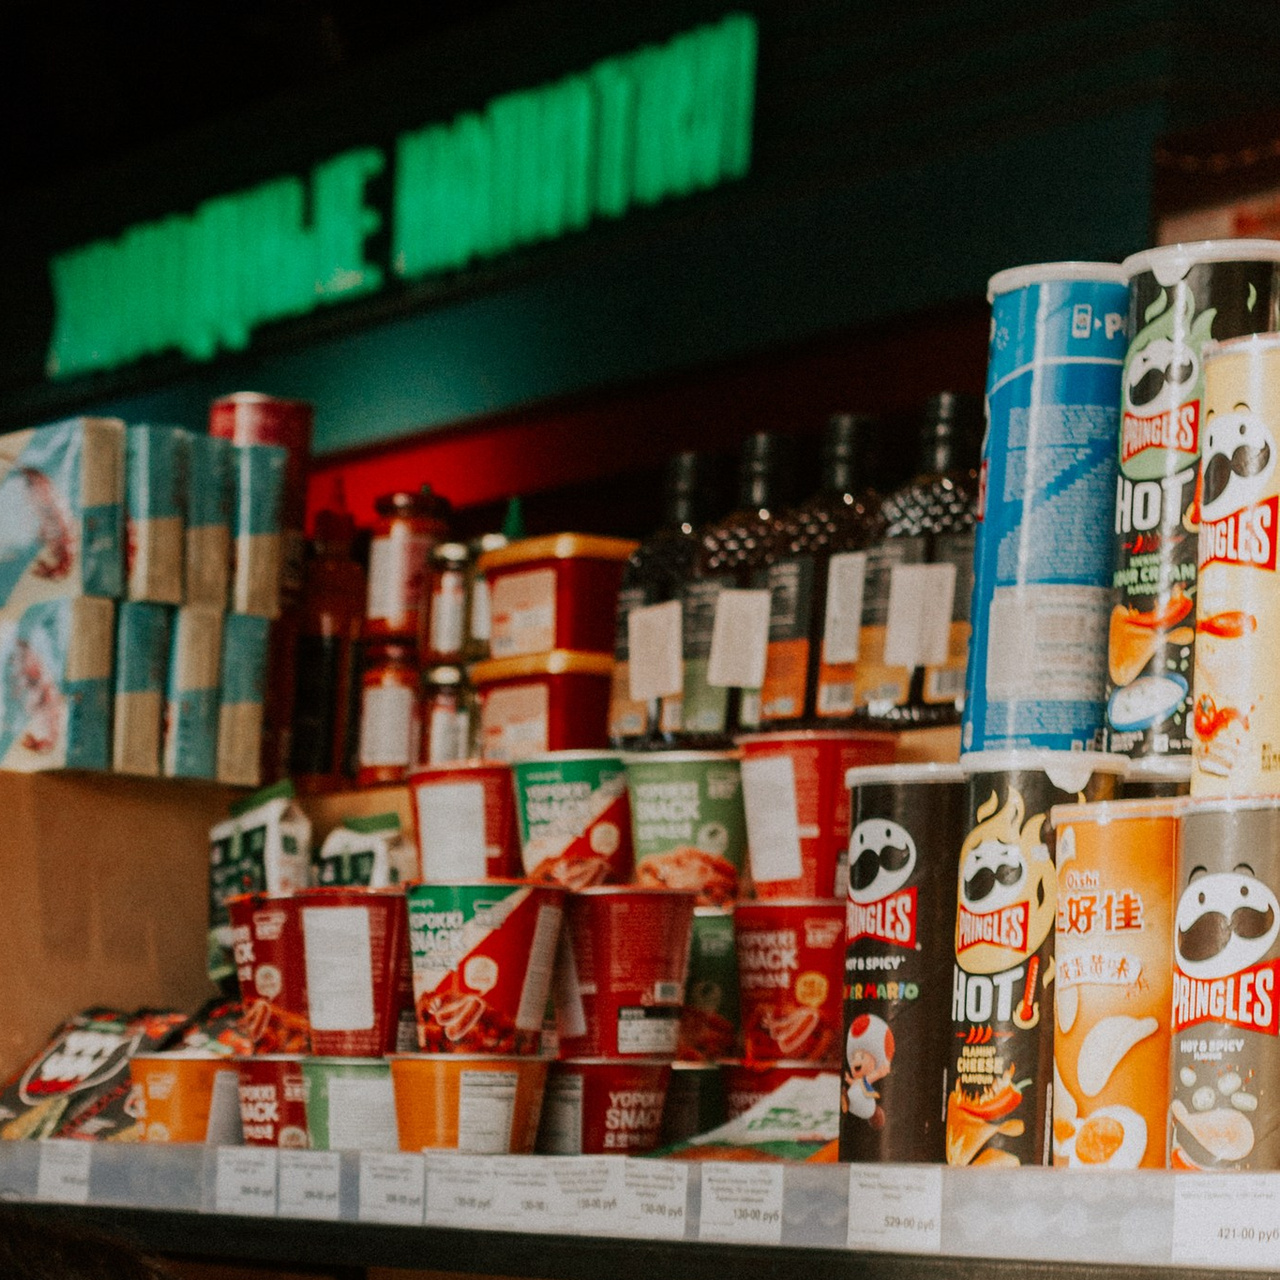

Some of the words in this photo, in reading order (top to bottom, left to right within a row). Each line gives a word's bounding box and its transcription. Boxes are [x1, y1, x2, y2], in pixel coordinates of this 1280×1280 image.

[1115, 468, 1195, 534] HOT
[958, 906, 1025, 949] PRINGLES
[865, 981, 919, 1000] MARIO
[1171, 968, 1274, 1028] PRINGLES
[957, 1057, 1004, 1074] CHEESE
